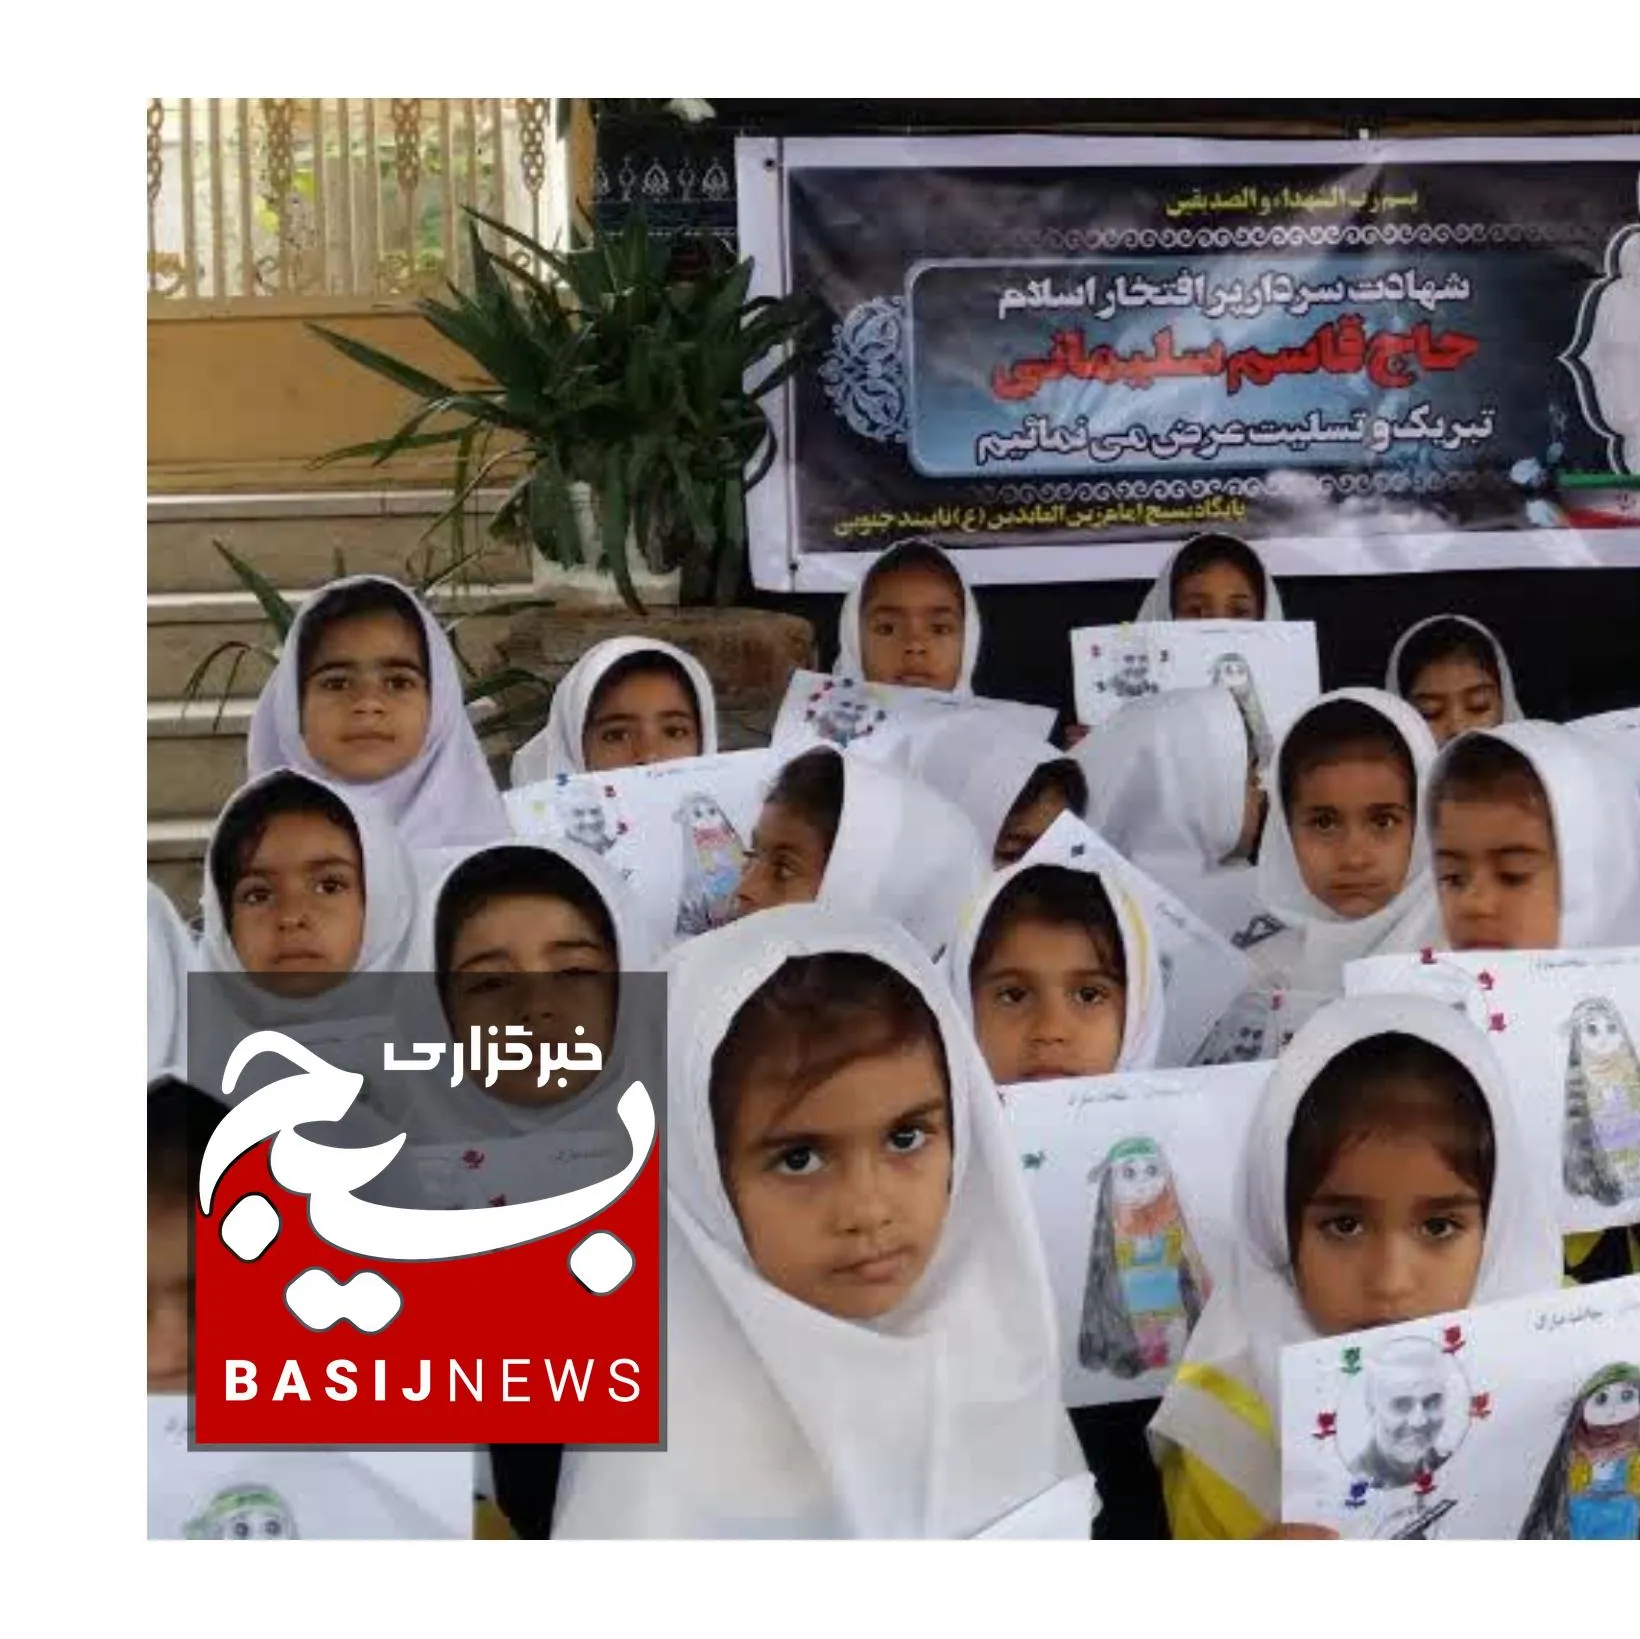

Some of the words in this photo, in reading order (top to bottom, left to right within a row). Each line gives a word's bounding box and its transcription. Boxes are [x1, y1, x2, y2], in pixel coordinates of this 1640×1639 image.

[998, 276, 1096, 320] اسلام
[1100, 267, 1205, 320] افتخار
[1247, 271, 1344, 315] سردار
[1347, 269, 1471, 311] شهادت
[991, 323, 1225, 401] سلیمانی
[1226, 312, 1366, 395] قاسم
[1366, 318, 1480, 388] حاج
[1152, 415, 1247, 458] عرض
[1249, 407, 1366, 447] تسلیت
[1370, 418, 1390, 452] و
[1394, 403, 1495, 450] تبریک
